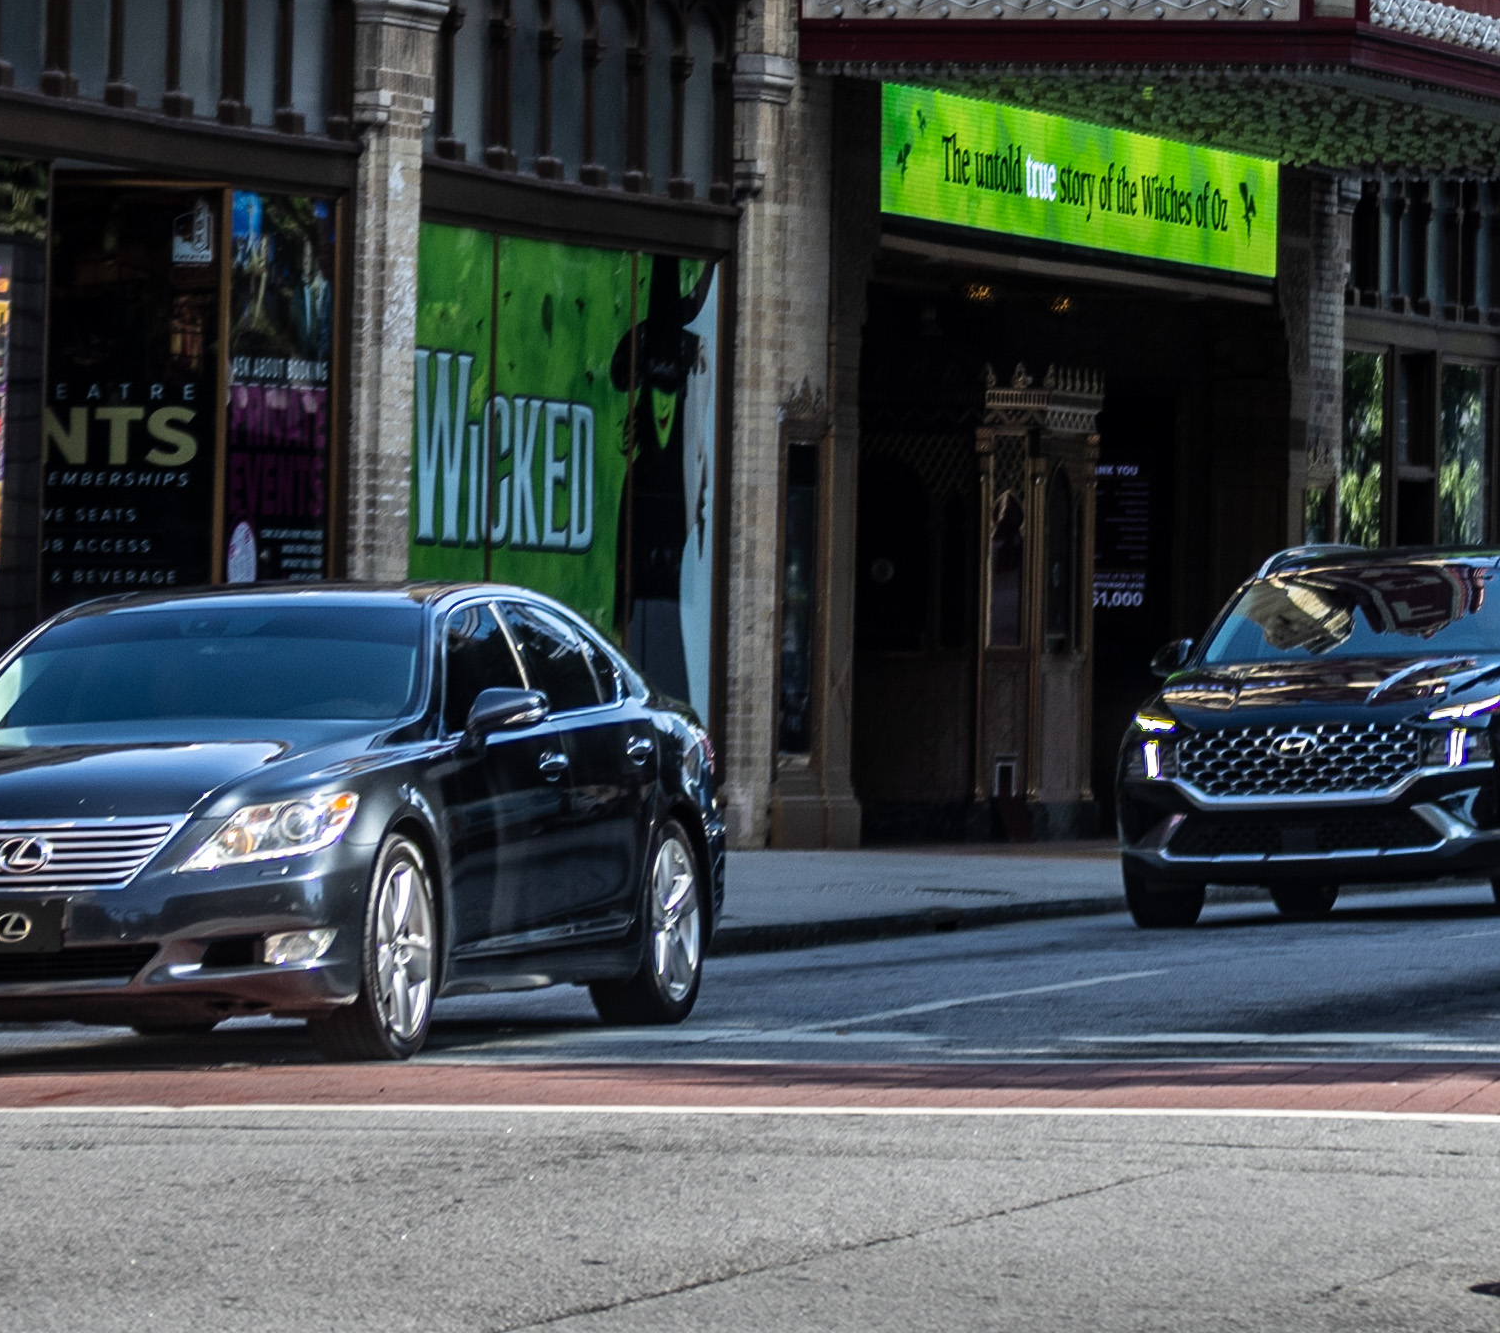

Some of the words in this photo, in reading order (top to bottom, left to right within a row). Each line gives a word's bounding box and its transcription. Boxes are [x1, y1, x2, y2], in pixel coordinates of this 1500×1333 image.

[941, 132, 971, 186] The
[974, 143, 1023, 196] untold
[1025, 153, 1057, 202] true
[1059, 165, 1095, 222] story
[1099, 162, 1115, 212] of
[1116, 166, 1138, 216] the
[1141, 174, 1193, 226] Witches
[1196, 180, 1211, 229] of
[1211, 188, 1229, 232] Oz
